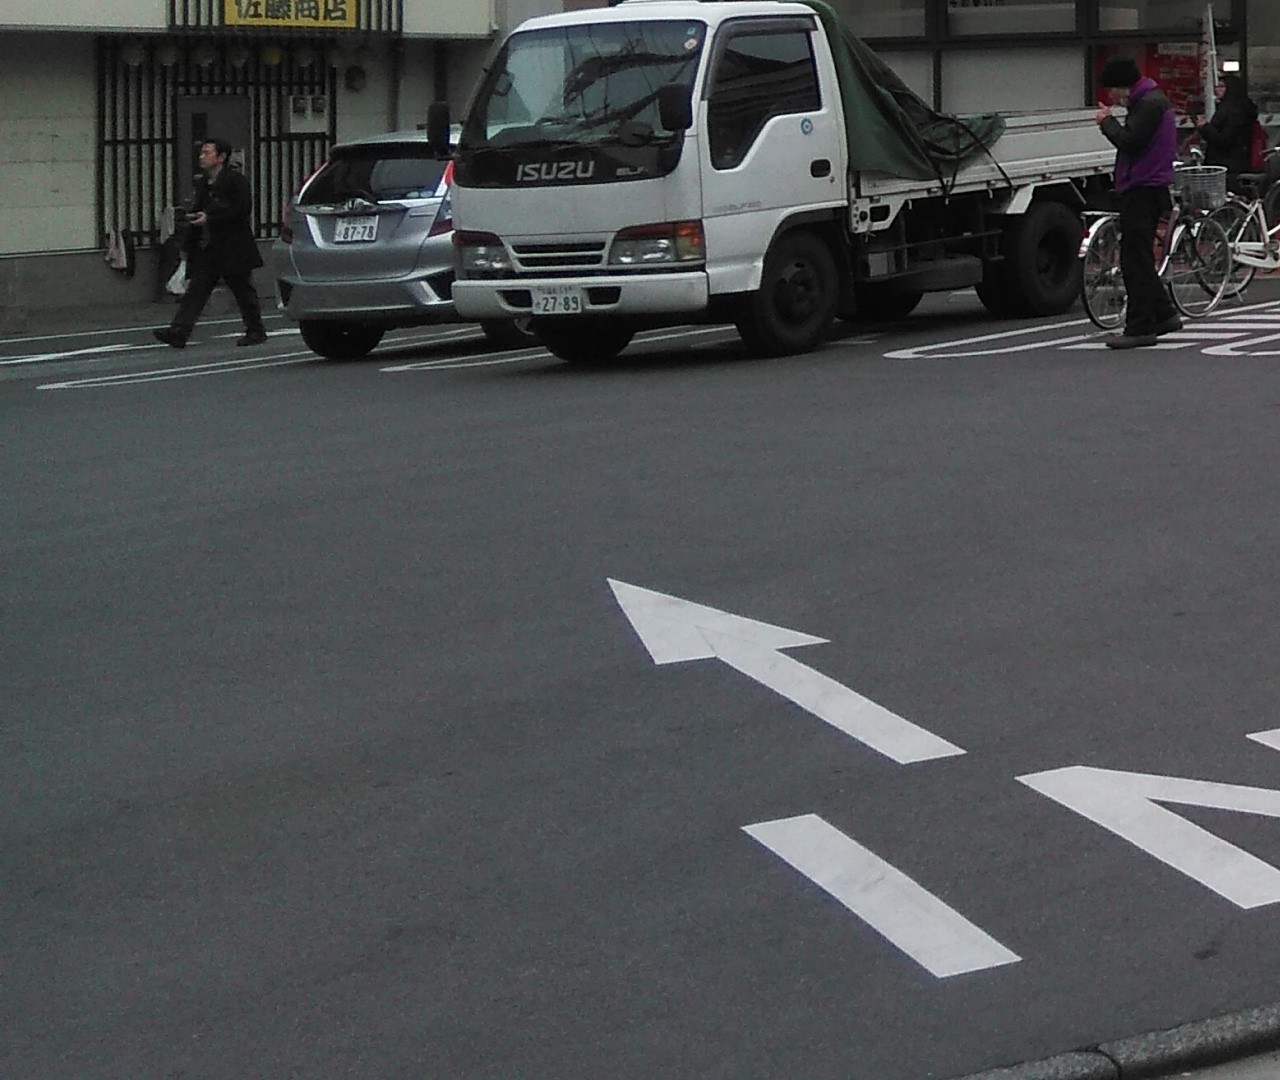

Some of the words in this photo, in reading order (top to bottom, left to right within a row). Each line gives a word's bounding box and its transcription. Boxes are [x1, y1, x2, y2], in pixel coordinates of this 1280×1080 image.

[516, 160, 595, 182] ISUZU
[343, 225, 374, 240] 87-78
[542, 295, 579, 312] 27-89
